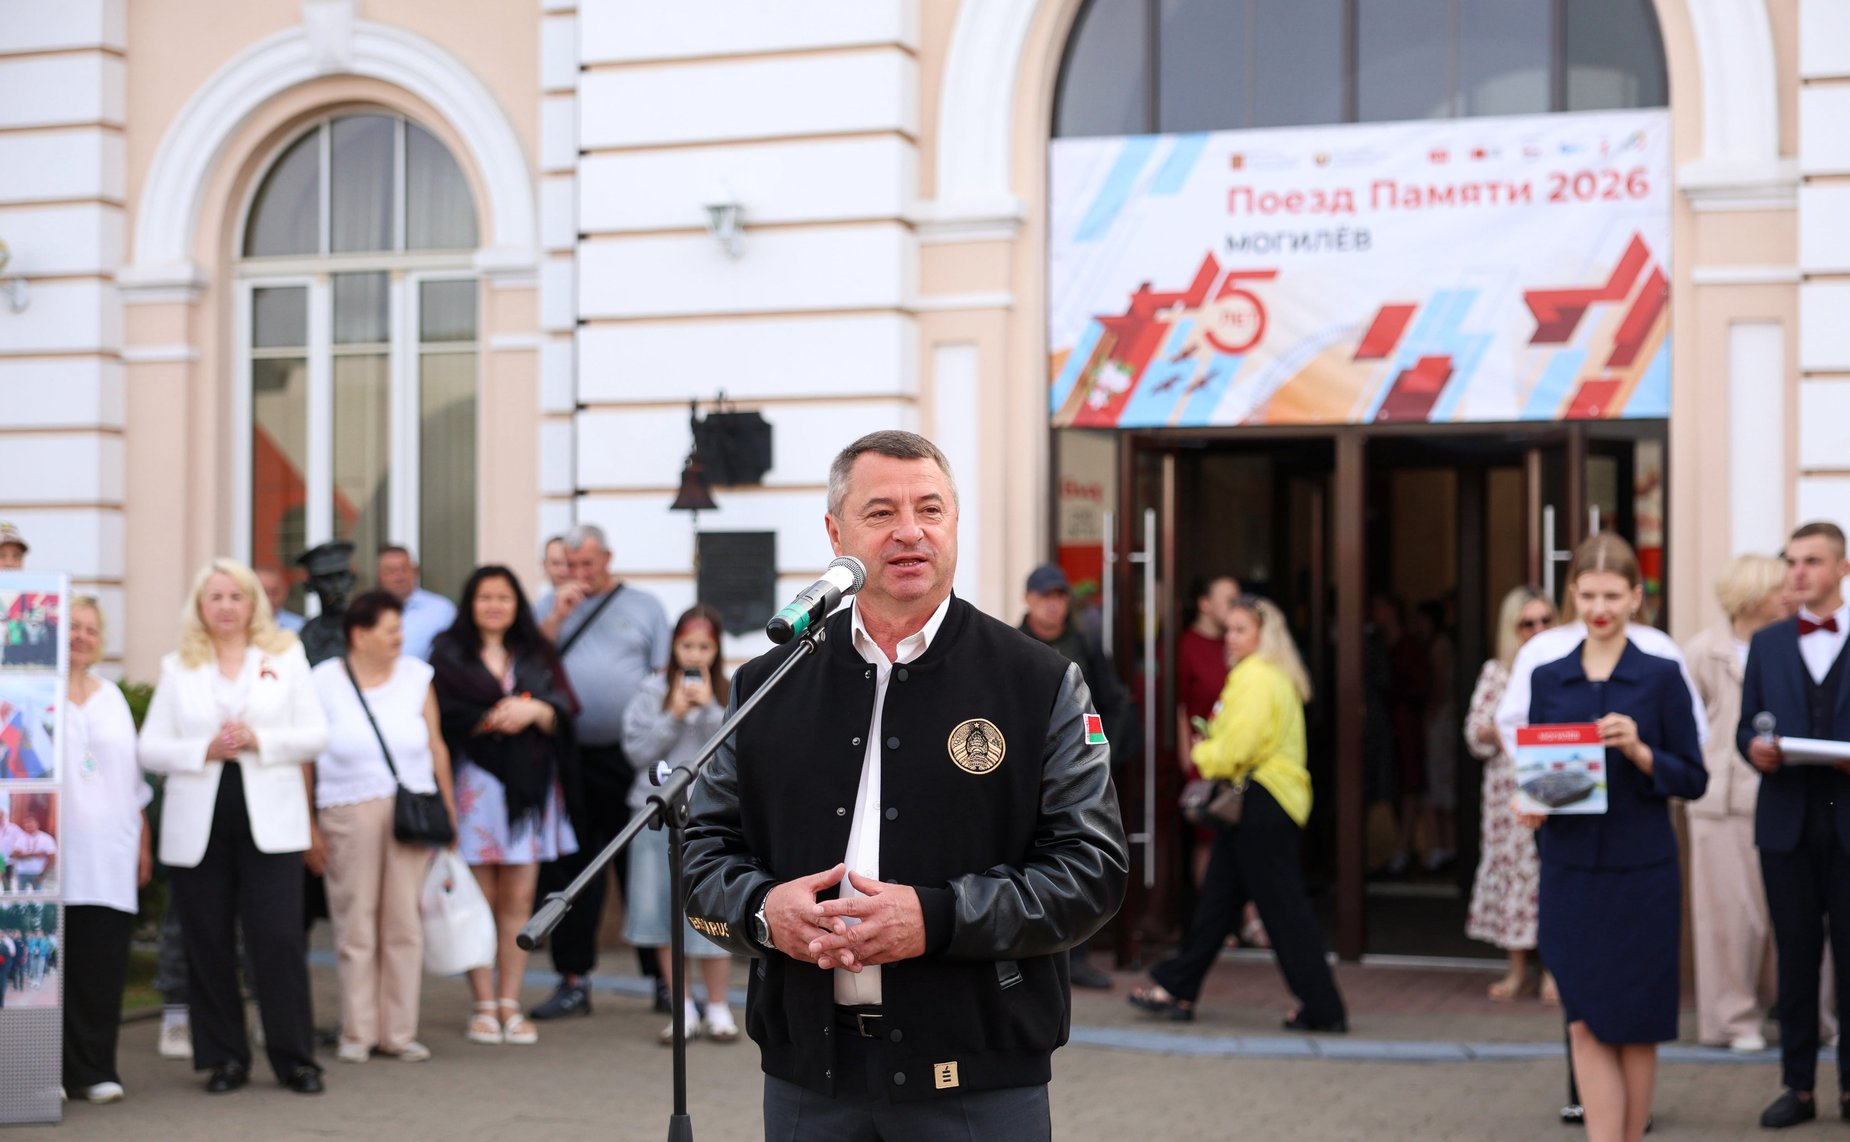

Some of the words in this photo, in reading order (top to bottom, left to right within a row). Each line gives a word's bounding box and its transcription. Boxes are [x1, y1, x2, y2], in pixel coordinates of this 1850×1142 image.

[1227, 186, 1357, 216] Поезд
[1370, 179, 1533, 210] Памяти
[1547, 166, 1651, 204] 2026
[1225, 226, 1371, 254] МОГИЛЁВ
